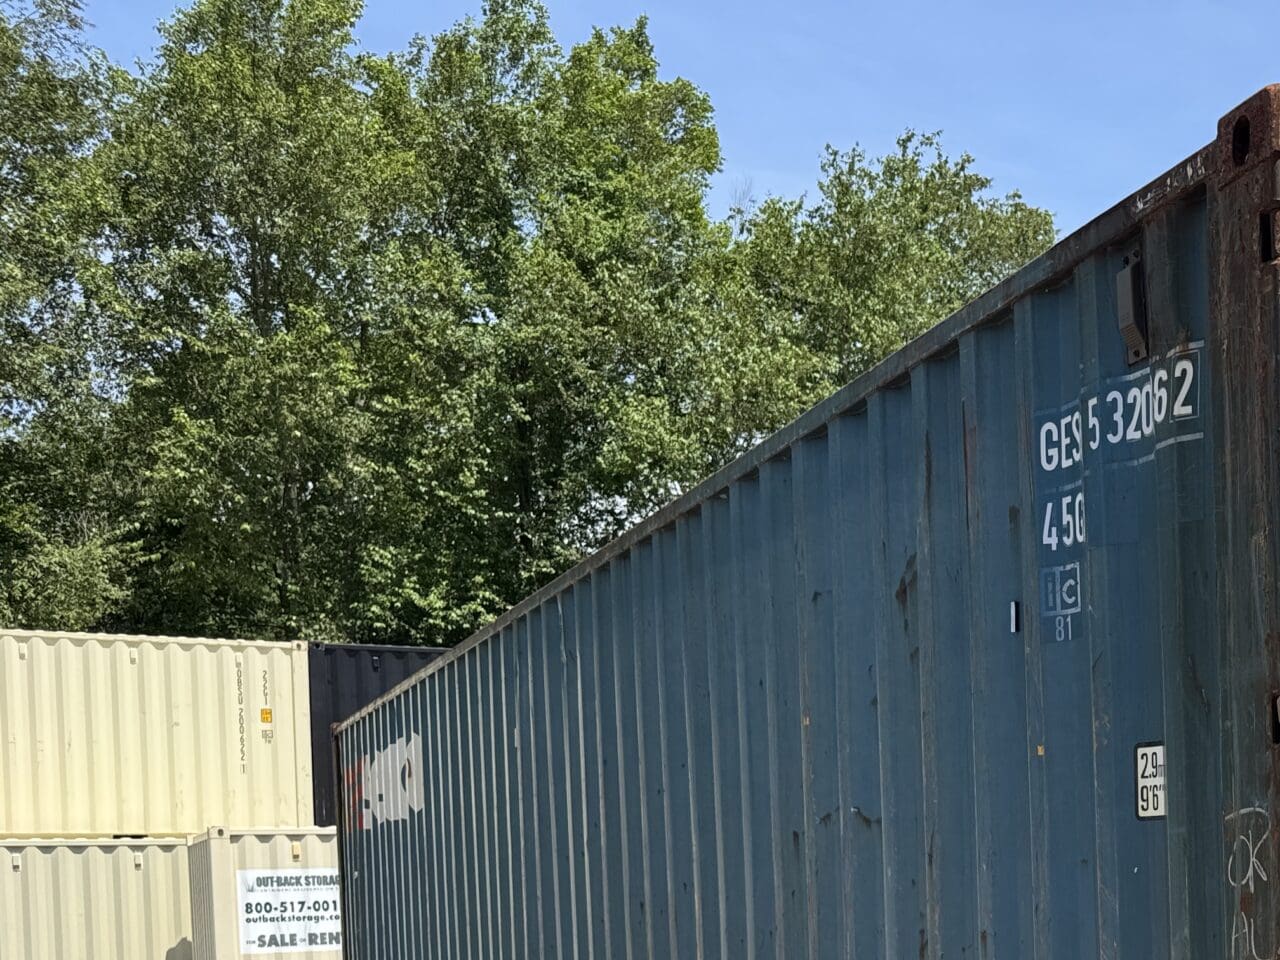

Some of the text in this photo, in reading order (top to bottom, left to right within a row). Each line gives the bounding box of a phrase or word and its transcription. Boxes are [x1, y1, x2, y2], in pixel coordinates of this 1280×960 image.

[1040, 411, 1084, 471] GES
[1173, 360, 1194, 416] 2
[1055, 615, 1072, 641] 81
[304, 875, 340, 886] STORAG
[245, 900, 338, 914] 800-517-001
[245, 914, 340, 923] outbackstorage.co
[257, 934, 298, 948] SALE
[308, 932, 341, 946] REN
